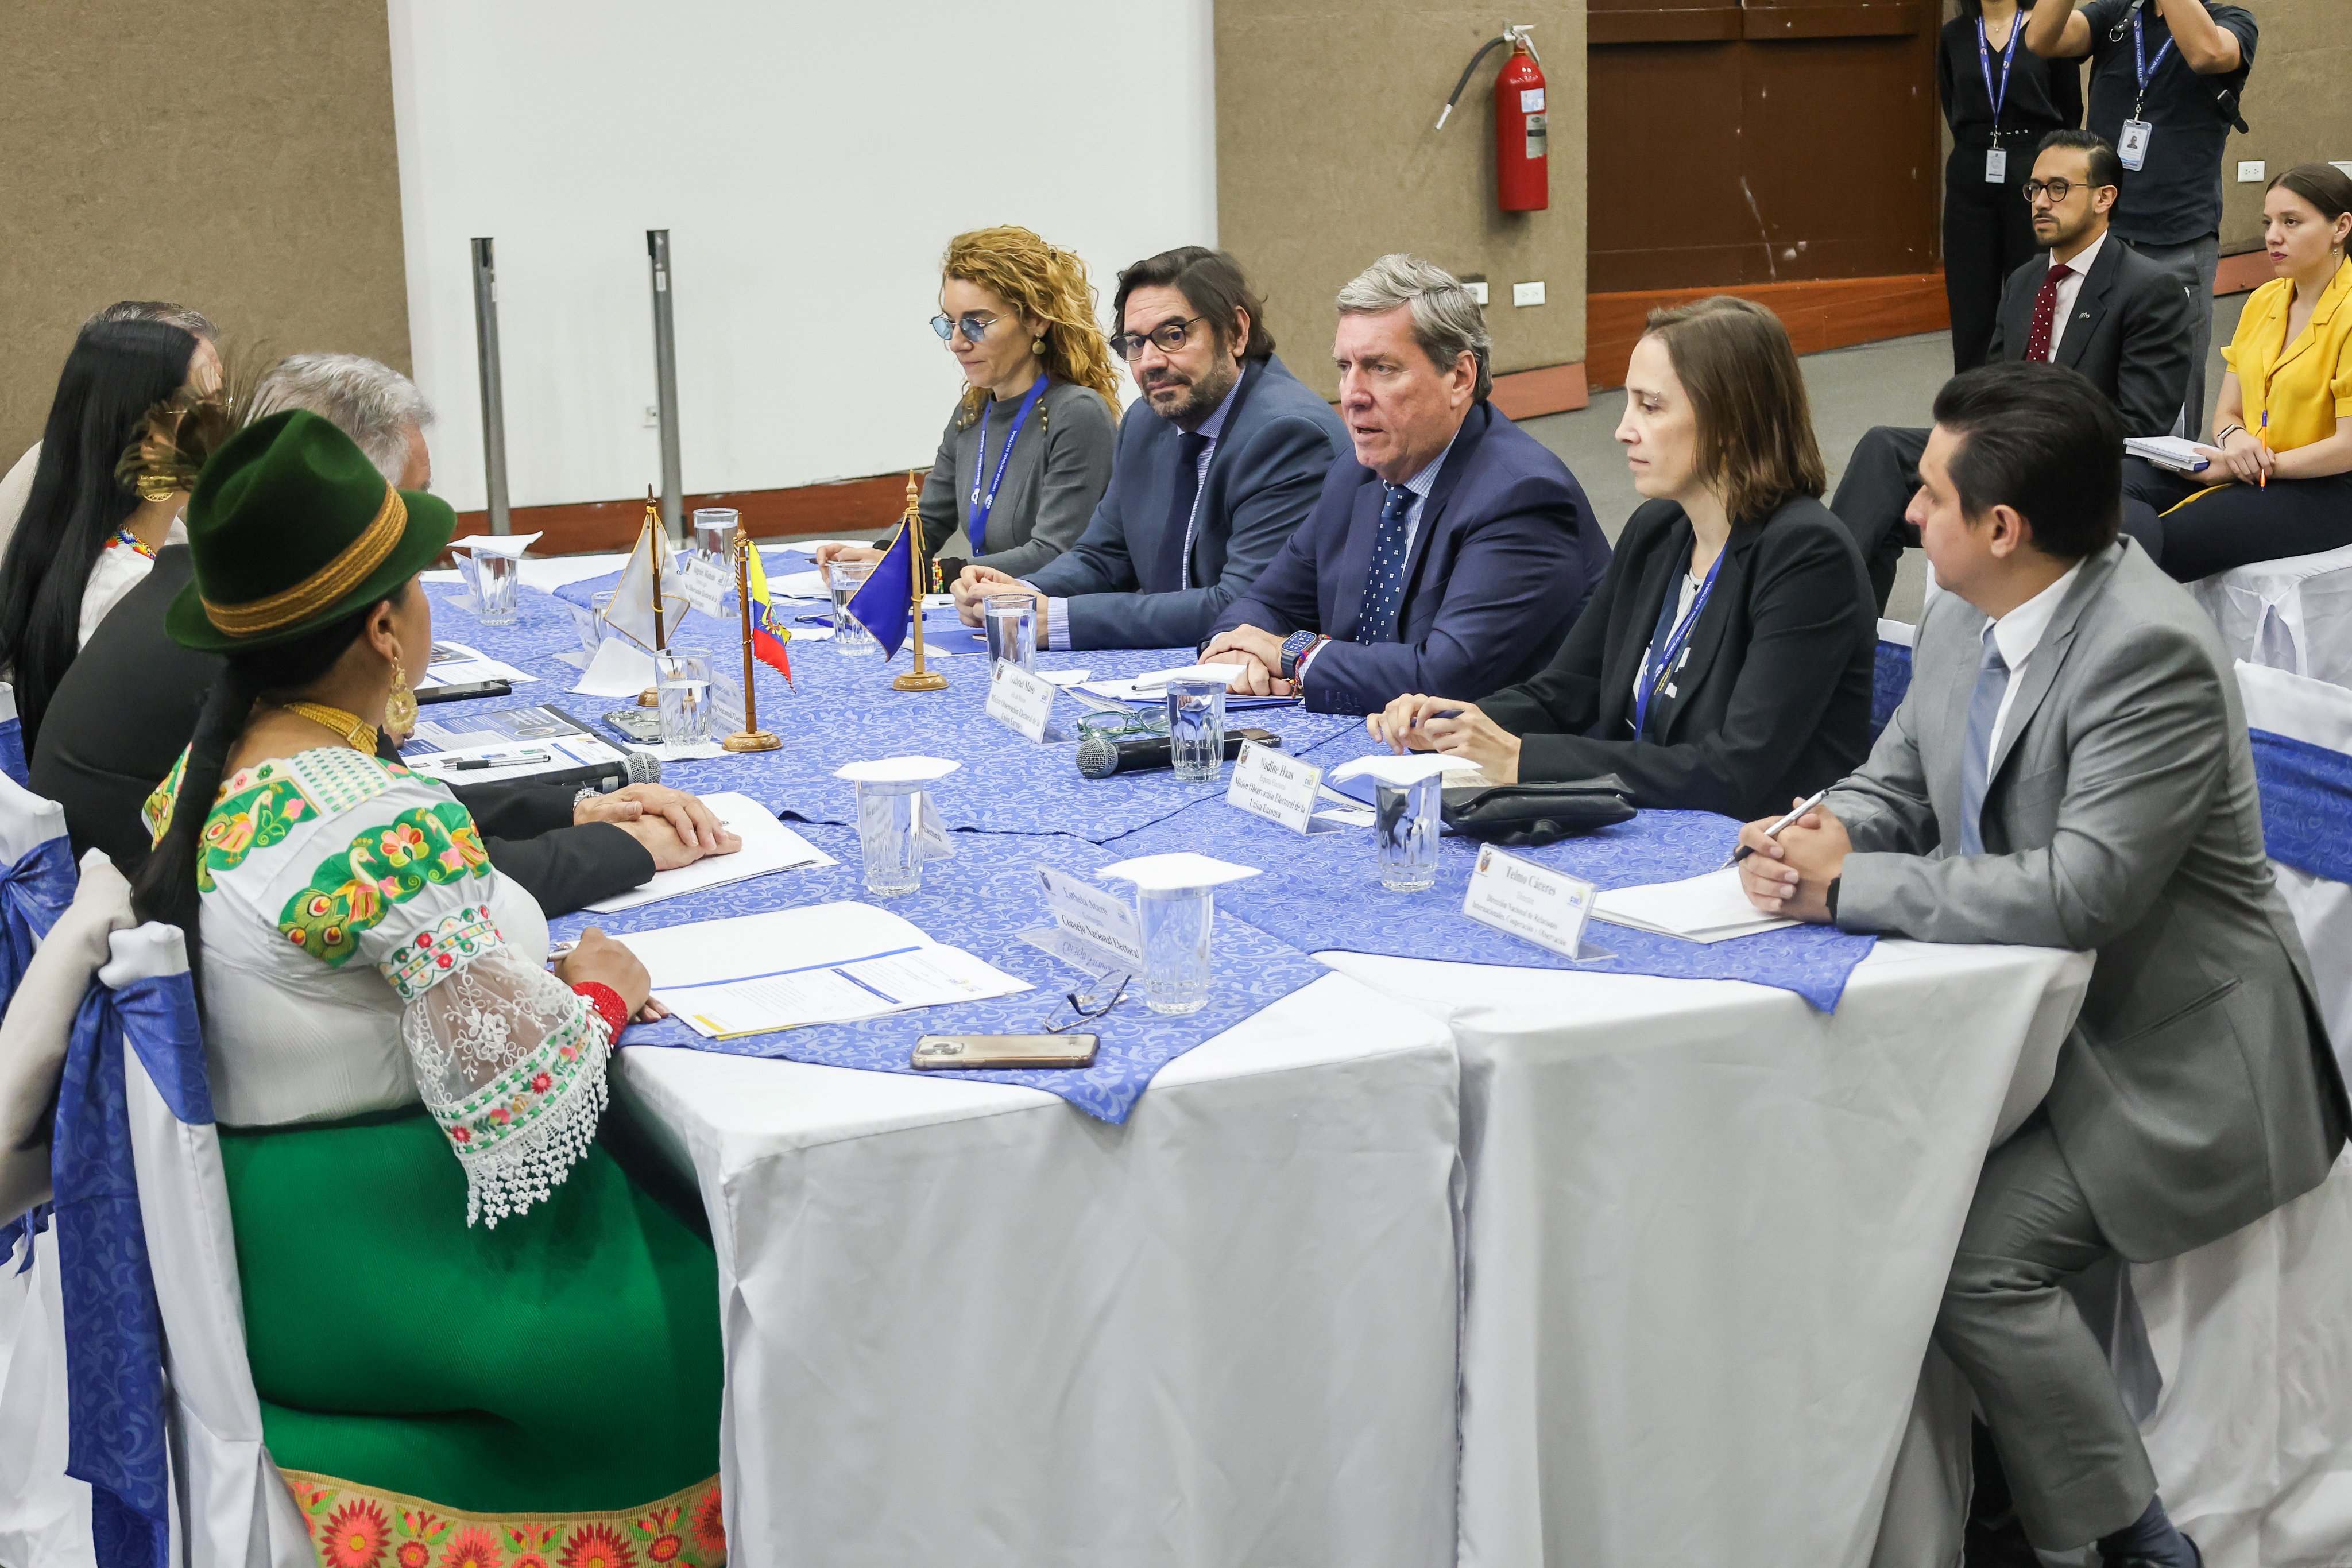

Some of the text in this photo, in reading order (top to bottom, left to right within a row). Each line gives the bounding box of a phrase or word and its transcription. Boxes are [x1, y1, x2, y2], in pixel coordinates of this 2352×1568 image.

[992, 430, 1017, 491] CONSEJO NACIONAL ELECTORAL
[1665, 636, 1680, 660] CONSEJO
[1011, 673, 1035, 694] Gabriel Mato
[1259, 757, 1294, 781] Nadine Haas
[1235, 776, 1305, 814] Misión Observación Electoral de la
[1250, 798, 1281, 819] Unión Europea
[1506, 866, 1557, 896] Telmo Cáceres
[1062, 914, 1086, 935] Consejo
[1085, 925, 1113, 946] Nacional
[1112, 936, 1140, 959] Electoral
